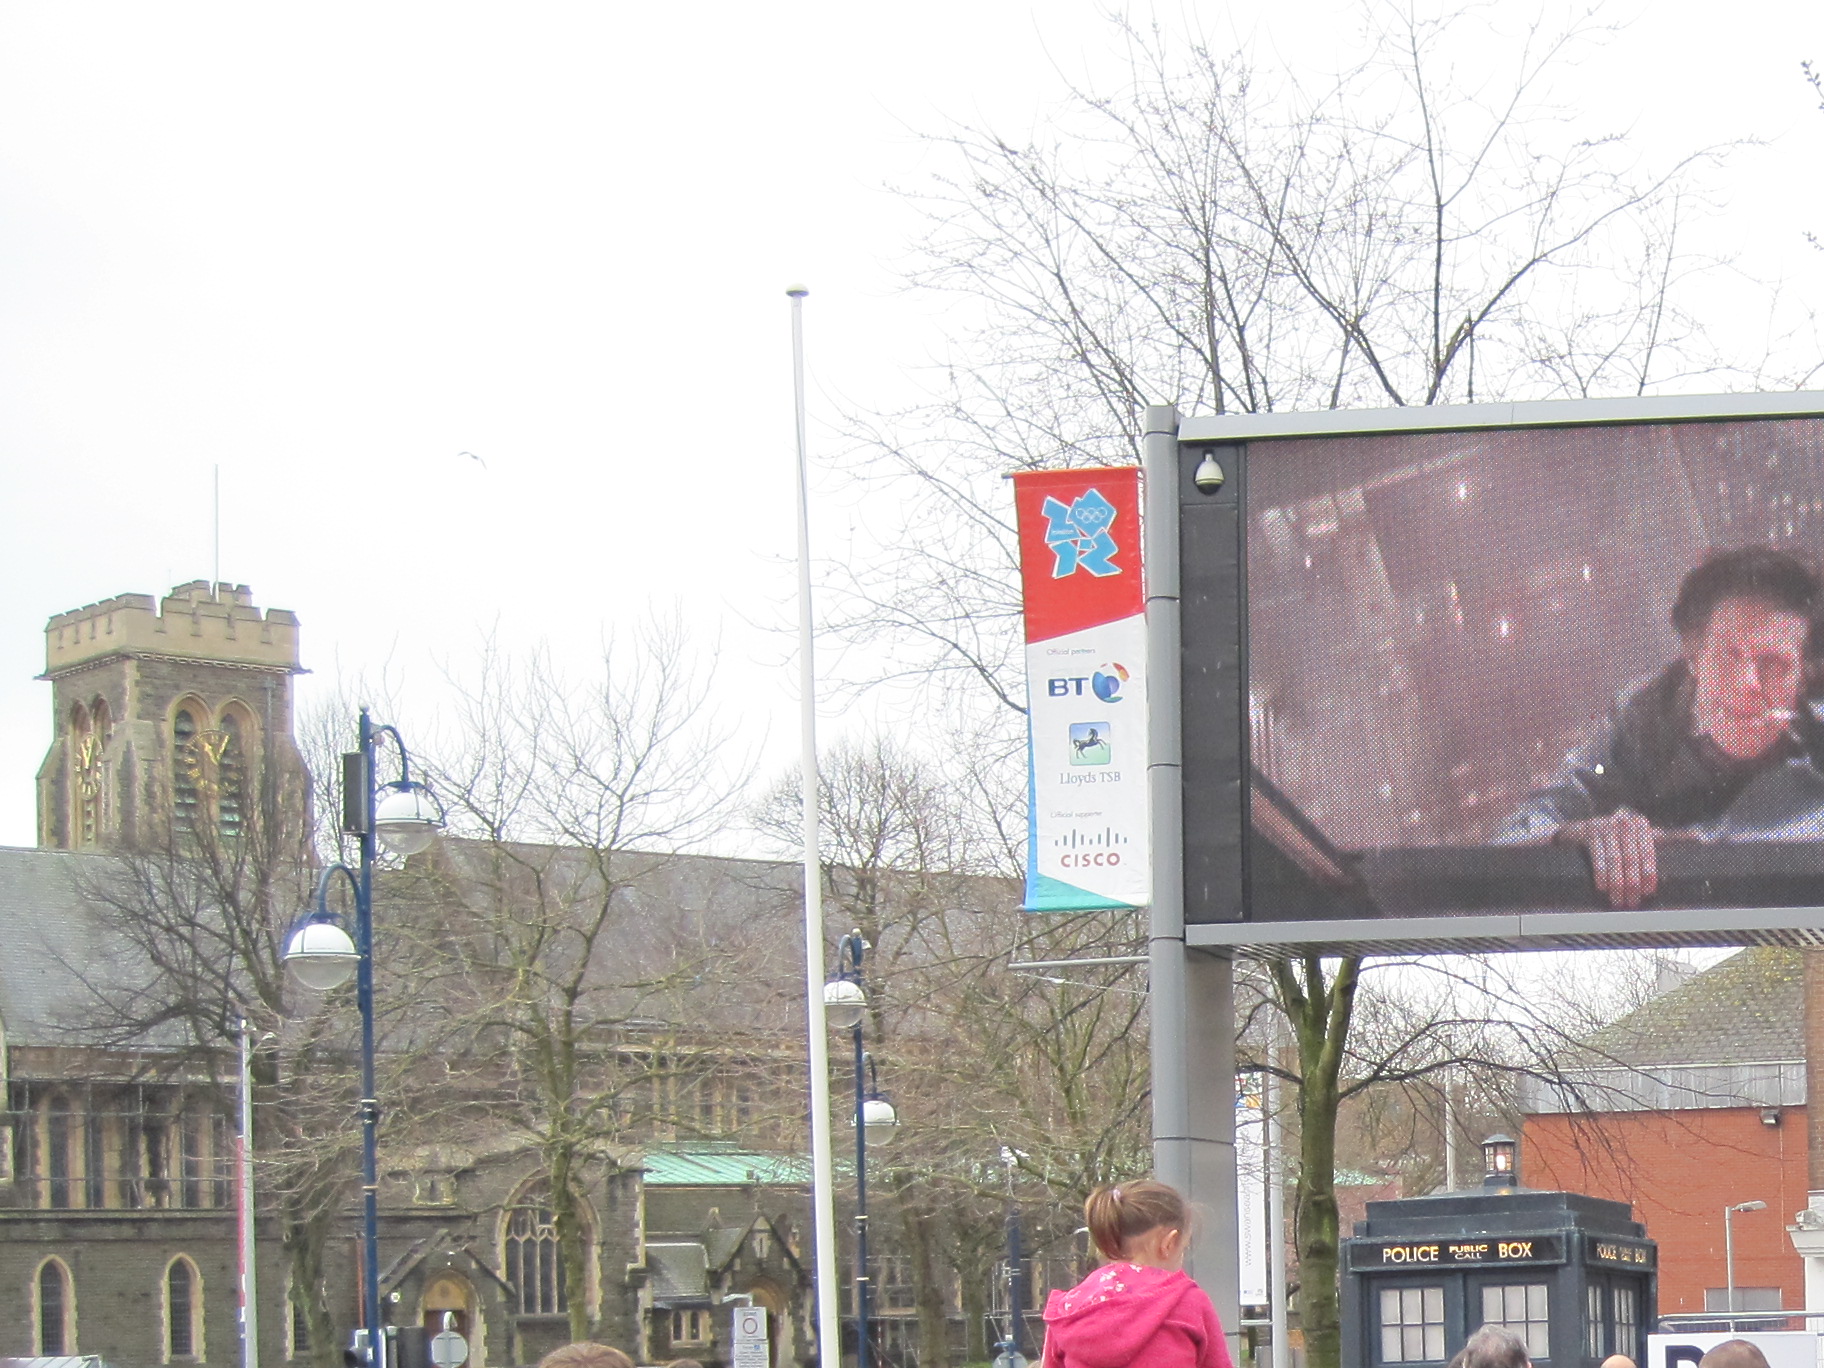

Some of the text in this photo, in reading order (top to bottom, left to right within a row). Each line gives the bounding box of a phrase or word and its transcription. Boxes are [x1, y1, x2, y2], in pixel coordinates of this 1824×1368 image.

[1048, 677, 1089, 696] BT
[1060, 771, 1121, 787] Lloyds TSB
[1060, 852, 1121, 867] CISCO
[1382, 1242, 1533, 1263] POLICE PUBLIC BOX
[1454, 1252, 1483, 1260] CALL
